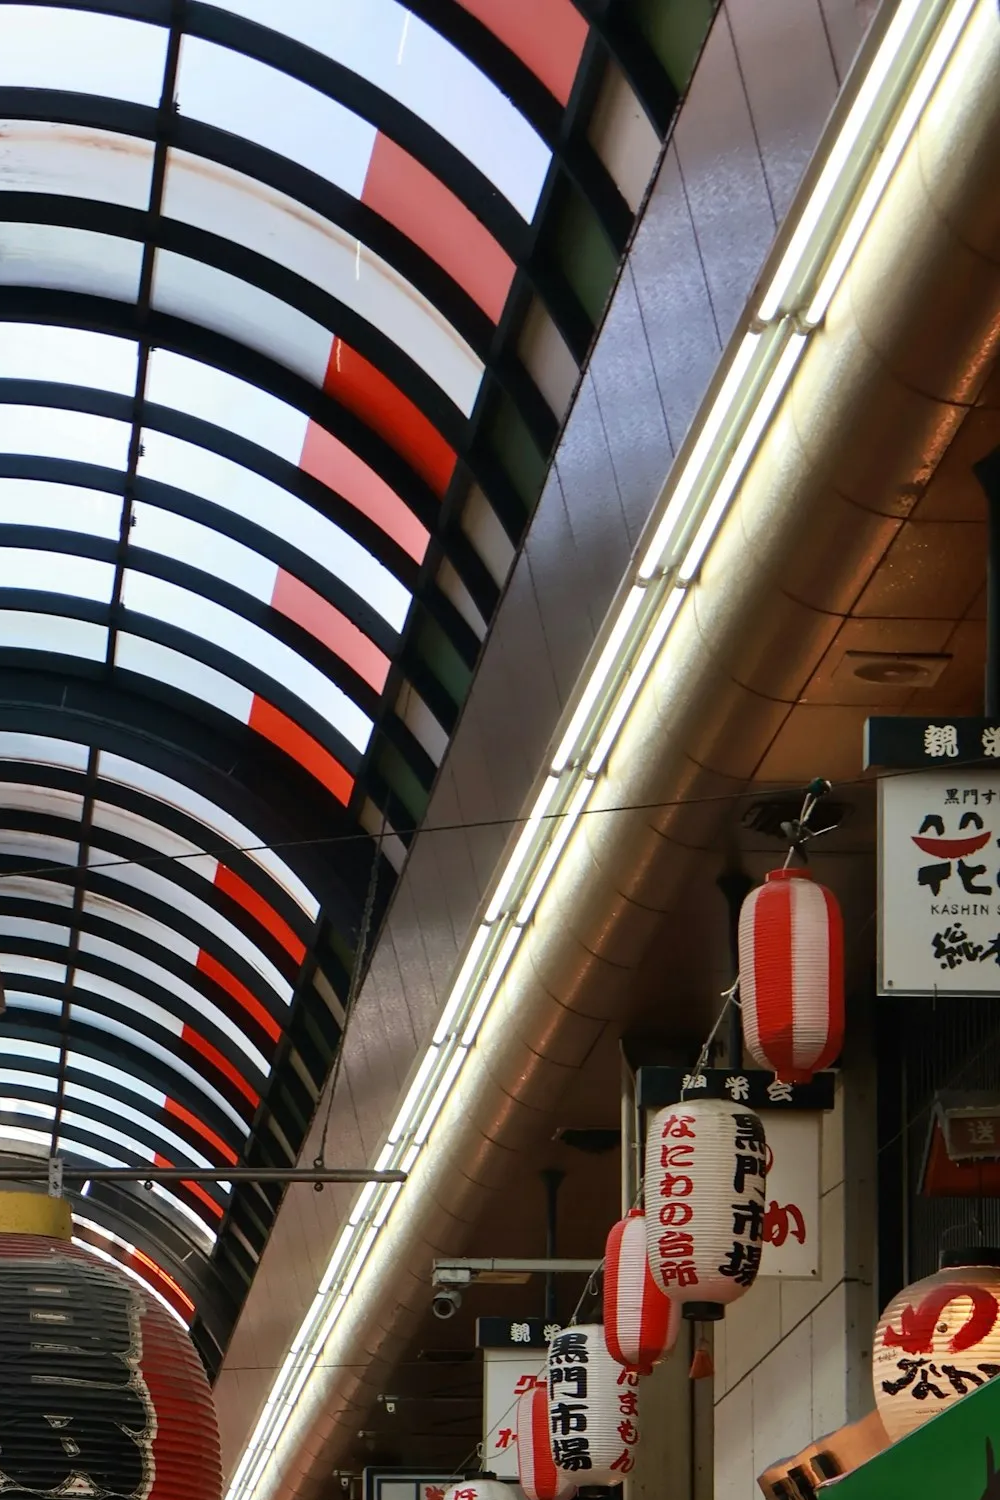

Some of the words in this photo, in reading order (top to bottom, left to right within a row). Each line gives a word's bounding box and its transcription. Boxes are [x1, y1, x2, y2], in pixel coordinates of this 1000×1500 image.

[944, 789, 1000, 805] 黒門す
[931, 904, 989, 915] KASHIN
[658, 1115, 699, 1287] なにわの台所
[549, 1332, 593, 1471] 黒門市場
[609, 1366, 639, 1473] んまもん
